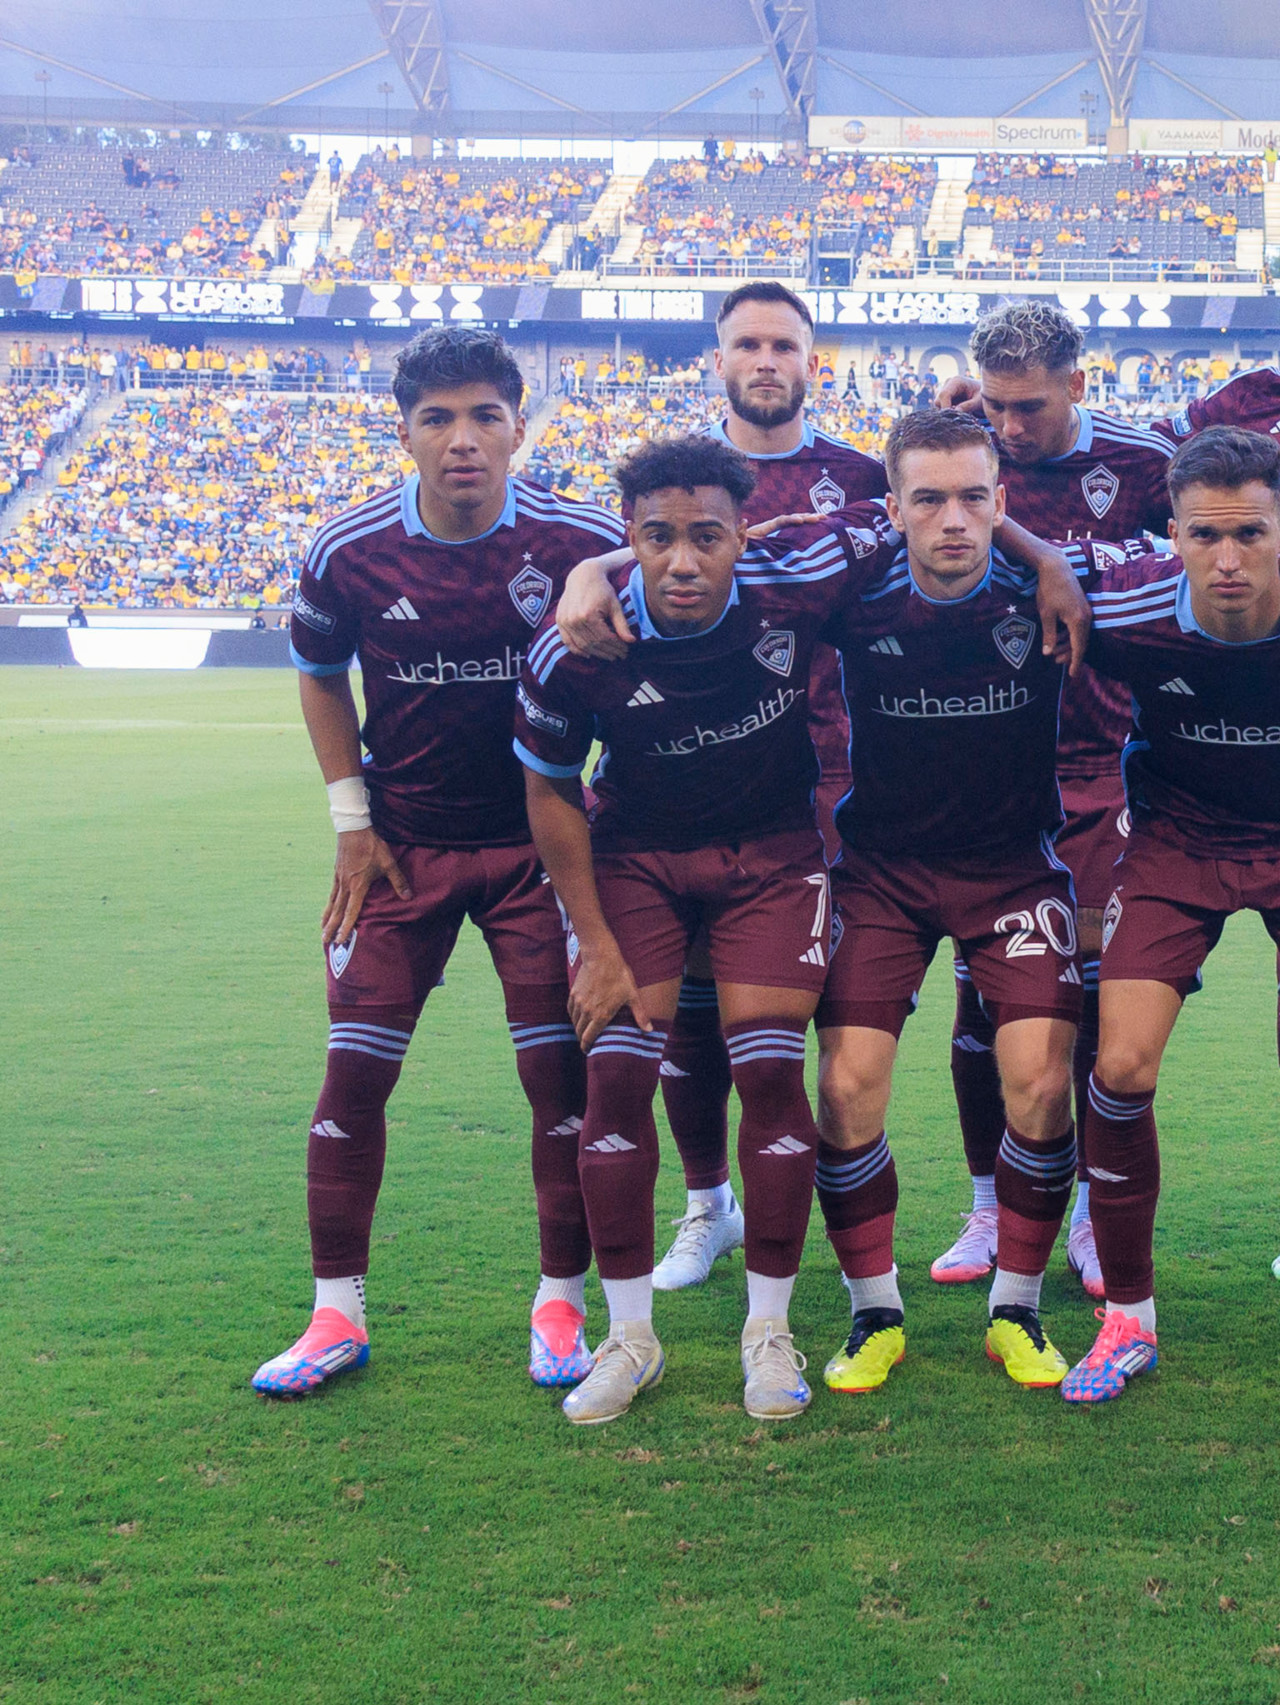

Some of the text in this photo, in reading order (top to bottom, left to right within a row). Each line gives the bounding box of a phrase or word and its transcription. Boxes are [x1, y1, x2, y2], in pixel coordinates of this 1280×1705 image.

[997, 125, 1076, 142] Spectrum
[393, 646, 526, 684] uchealt
[879, 680, 1028, 717] uchealth
[652, 687, 796, 755] uchealth
[994, 897, 1077, 958] 20
